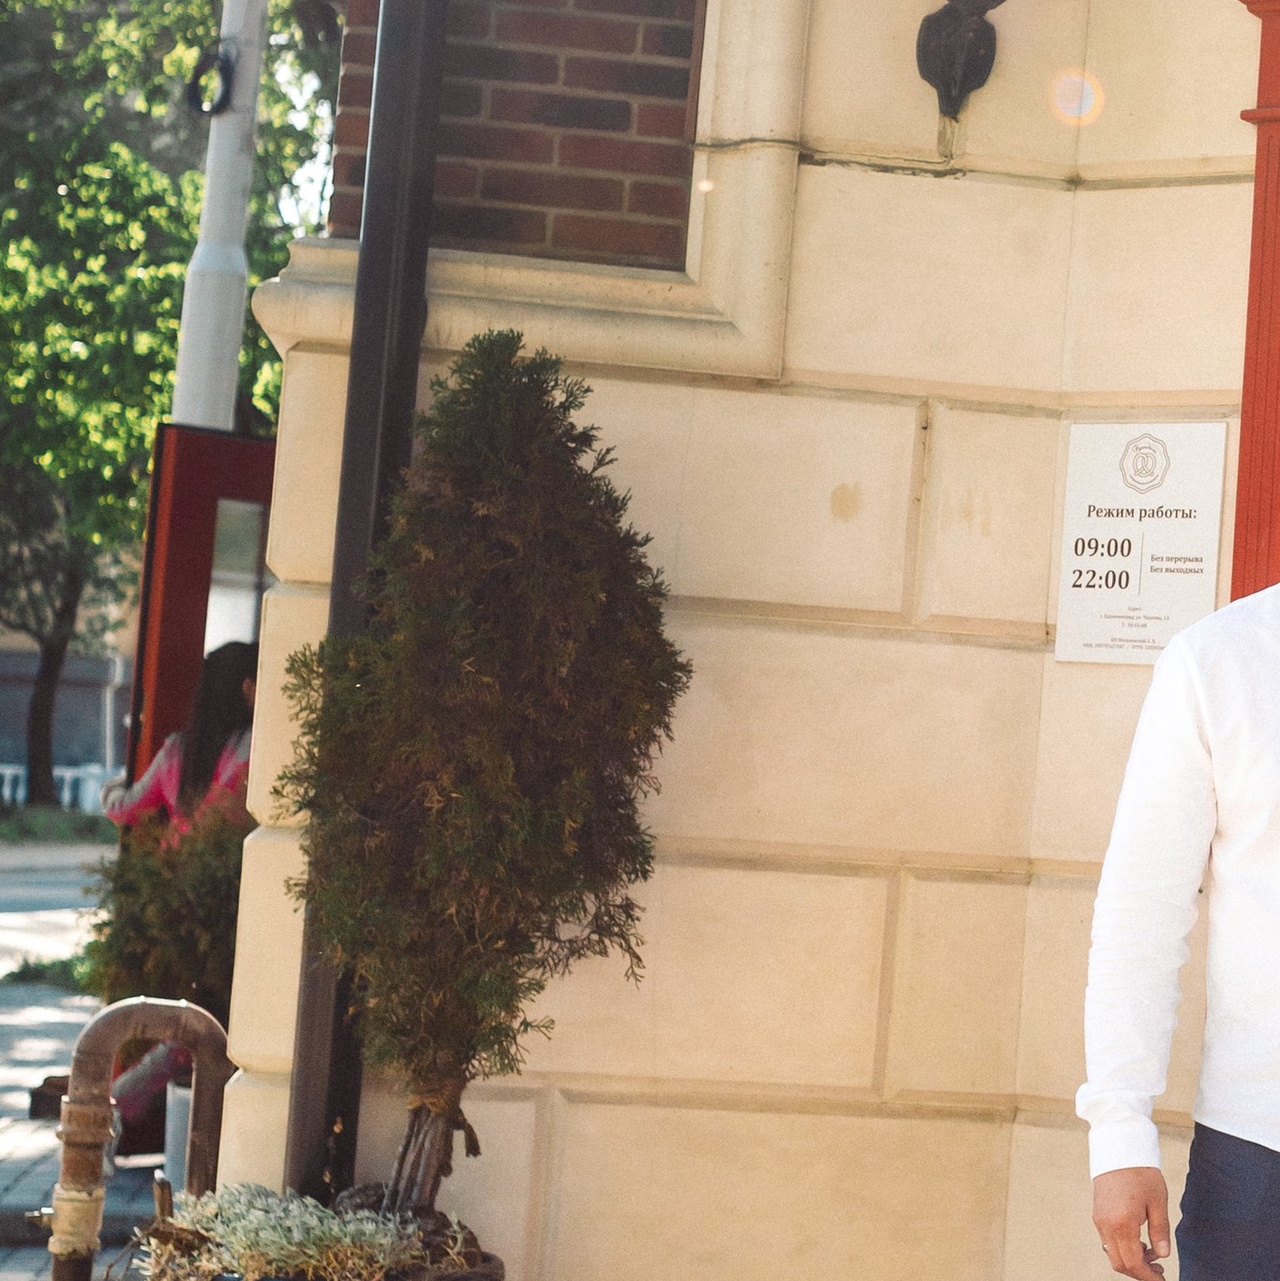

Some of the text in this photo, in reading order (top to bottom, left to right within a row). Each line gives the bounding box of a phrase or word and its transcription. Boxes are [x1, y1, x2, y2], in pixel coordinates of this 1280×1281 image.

[1087, 504, 1197, 521] Режим работы:
[1074, 538, 1132, 557] 09:00
[1150, 554, 1203, 564] Без перерыва
[1150, 565, 1204, 575] Без выходных
[1071, 569, 1130, 589] 22:00
